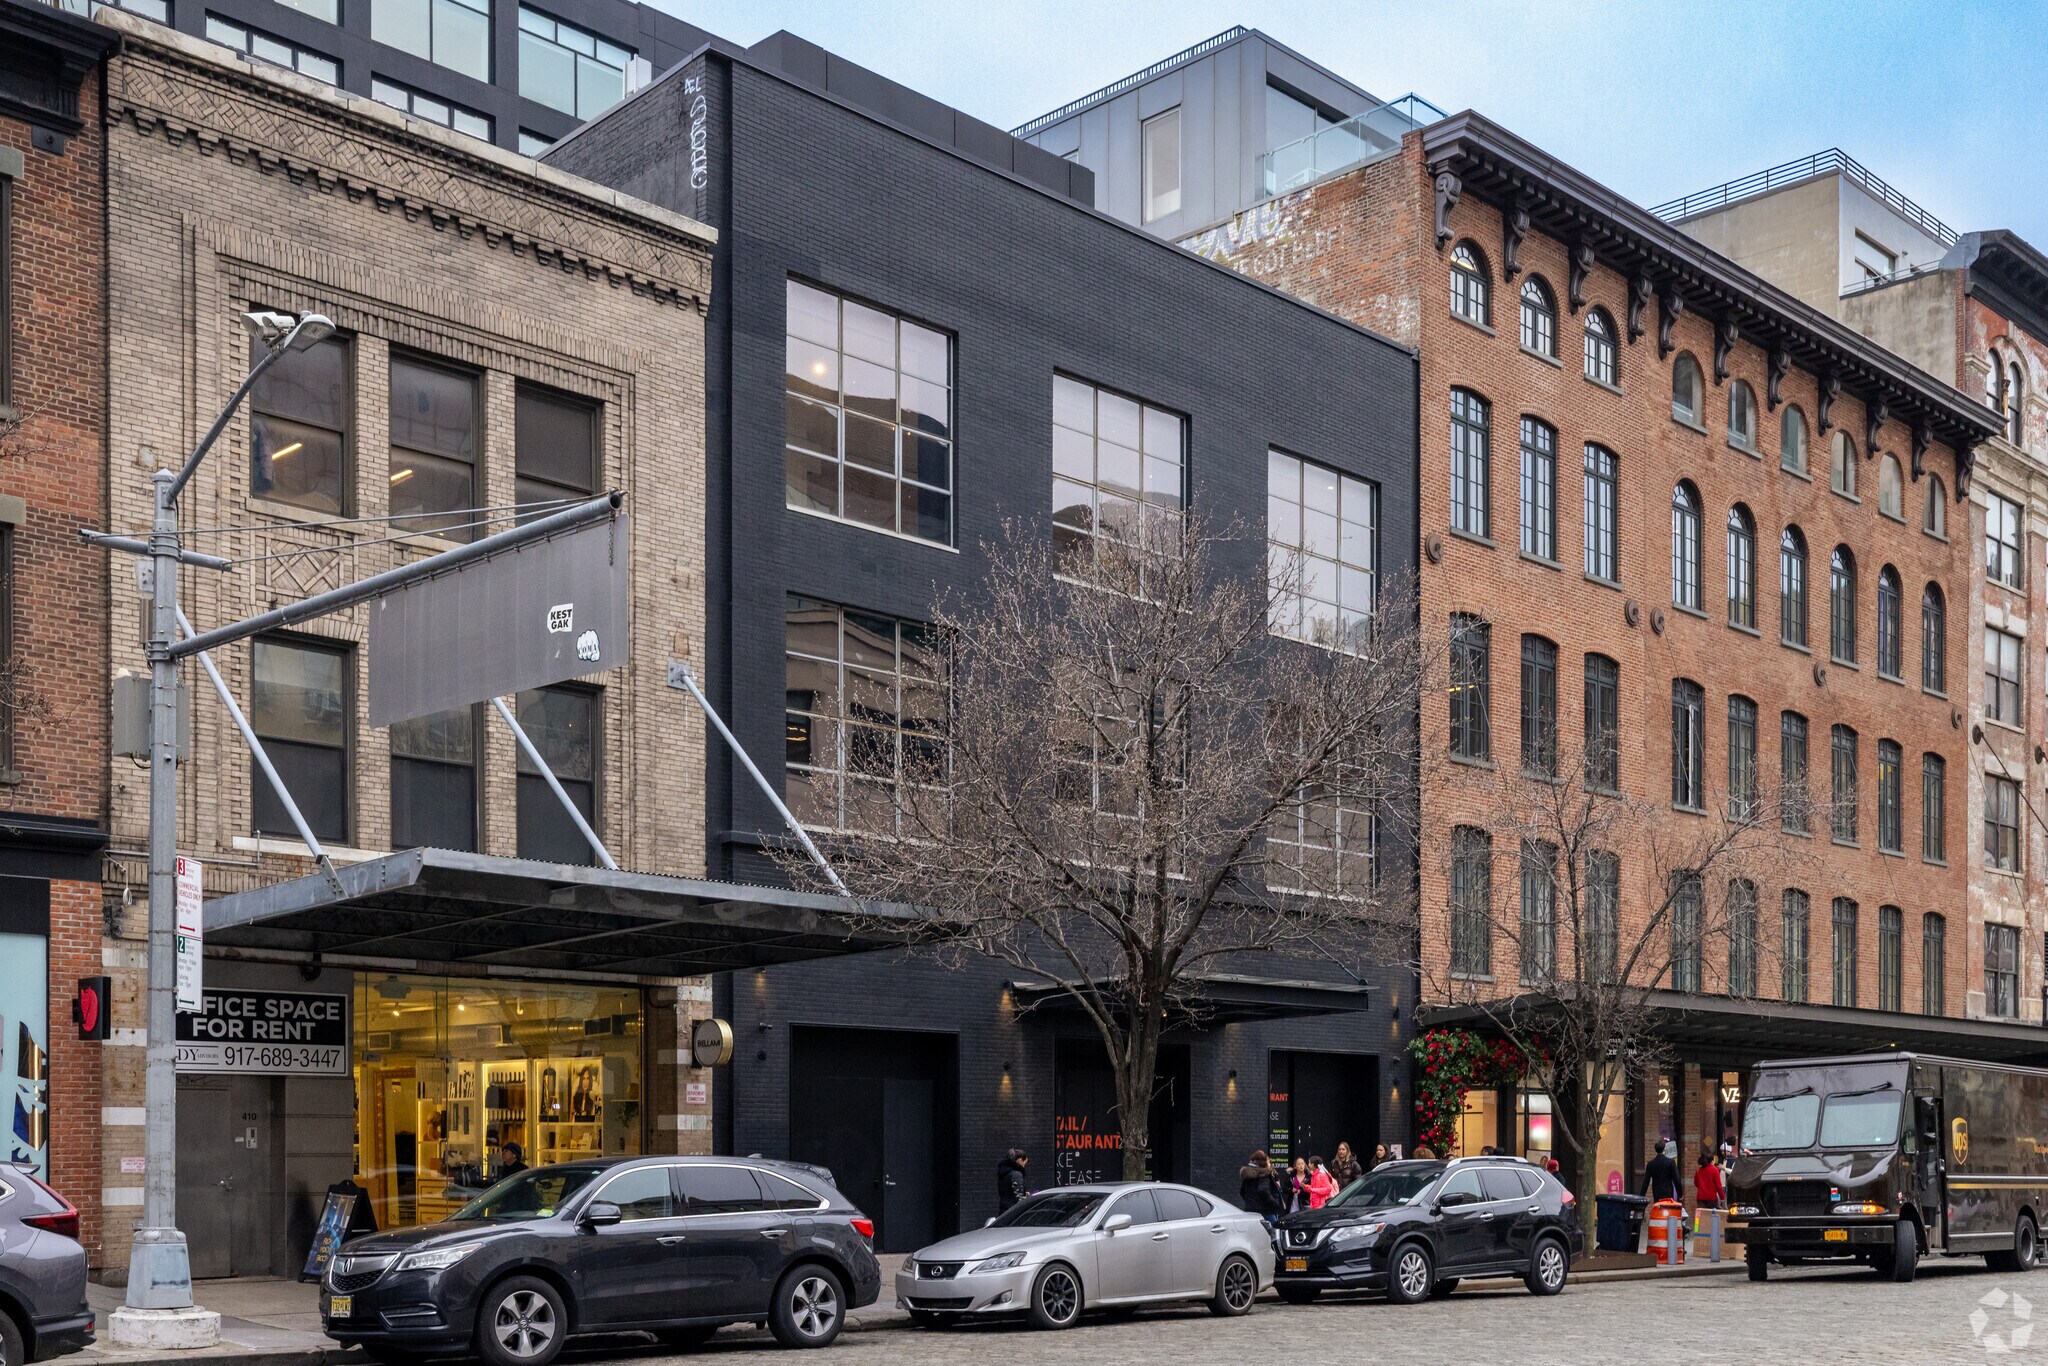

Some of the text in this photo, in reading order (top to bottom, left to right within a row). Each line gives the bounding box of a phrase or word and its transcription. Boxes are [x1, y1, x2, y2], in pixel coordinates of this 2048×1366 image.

[550, 609, 573, 620] KEST
[551, 619, 569, 630] GAK
[176, 996, 340, 1021] FICE SPACE
[192, 1018, 316, 1041] FOR RENT
[224, 1046, 340, 1068] 917-689-3447
[241, 1112, 257, 1120] 410
[1954, 1132, 1967, 1157] ups
[1056, 1152, 1073, 1168] CE
